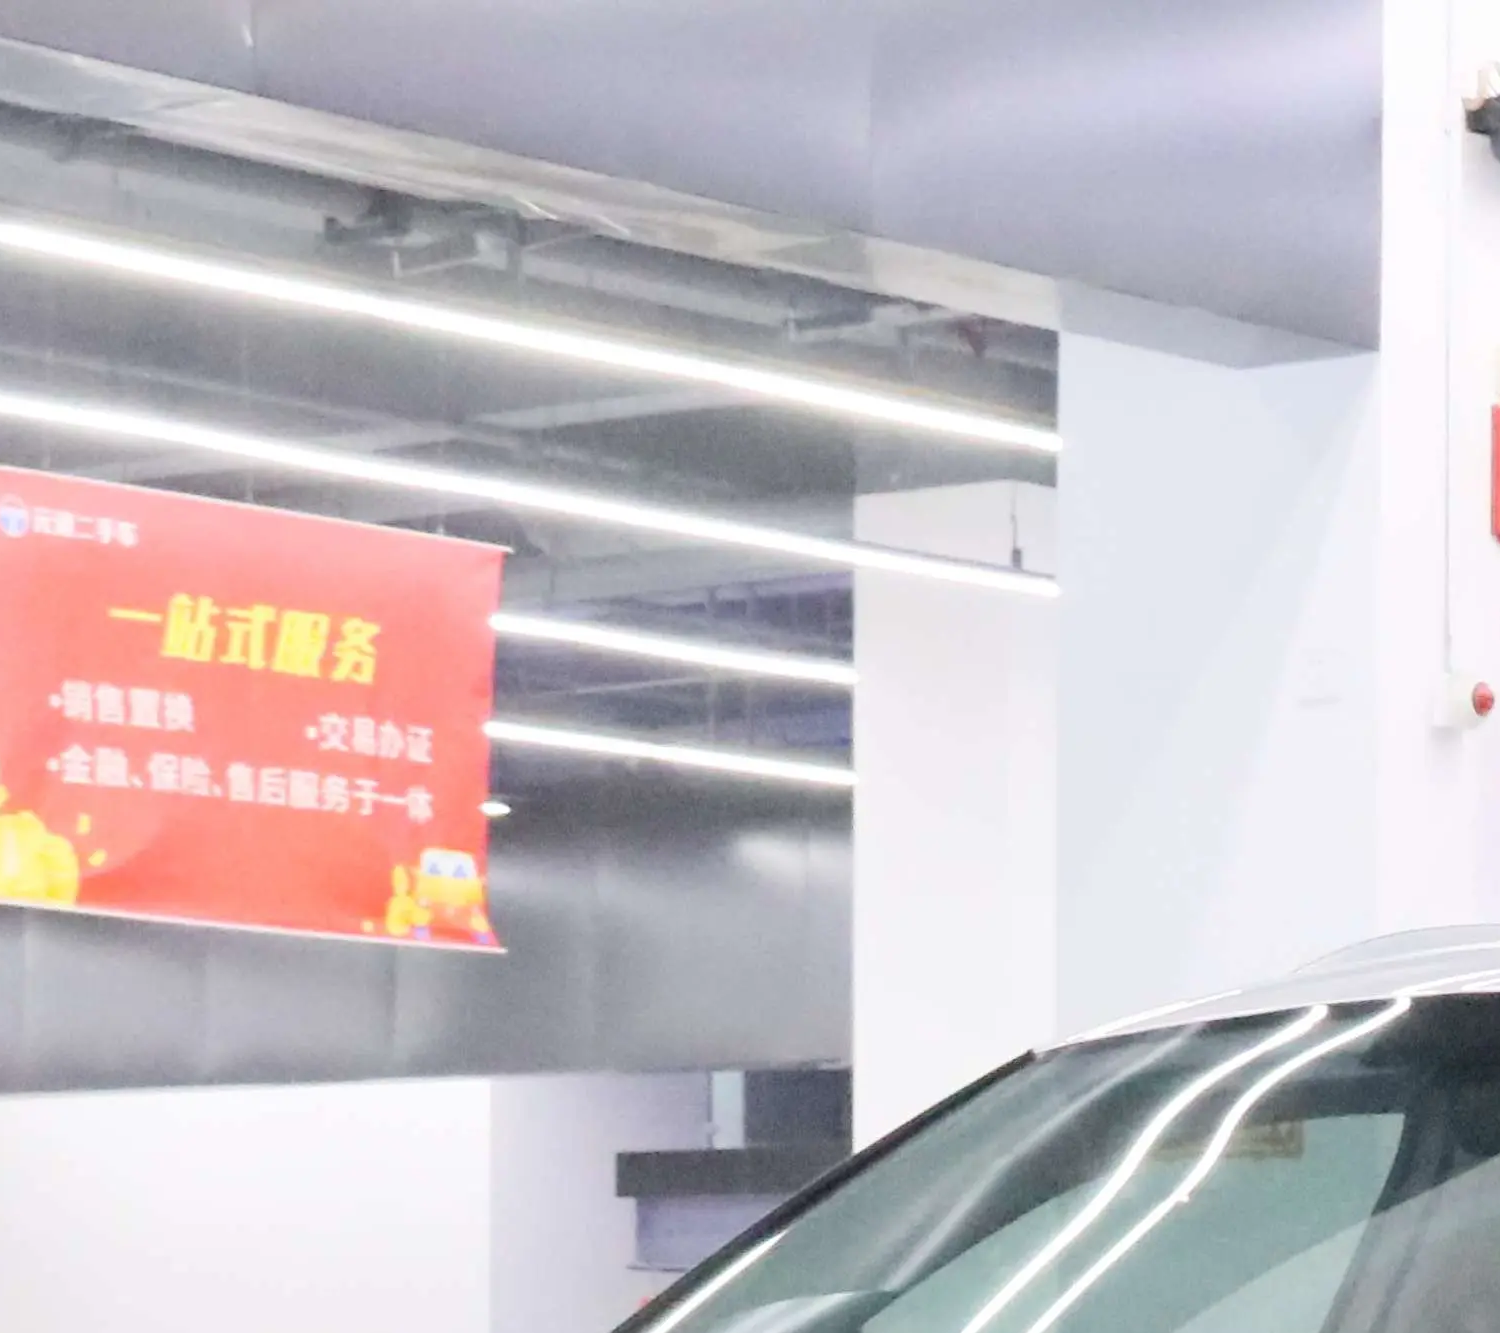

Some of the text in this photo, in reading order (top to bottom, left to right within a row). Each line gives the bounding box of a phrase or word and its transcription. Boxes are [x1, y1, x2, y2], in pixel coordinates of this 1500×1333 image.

[108, 592, 381, 685] 一站式服务
[61, 680, 196, 732] 销售置换
[318, 712, 434, 764] 交易办证
